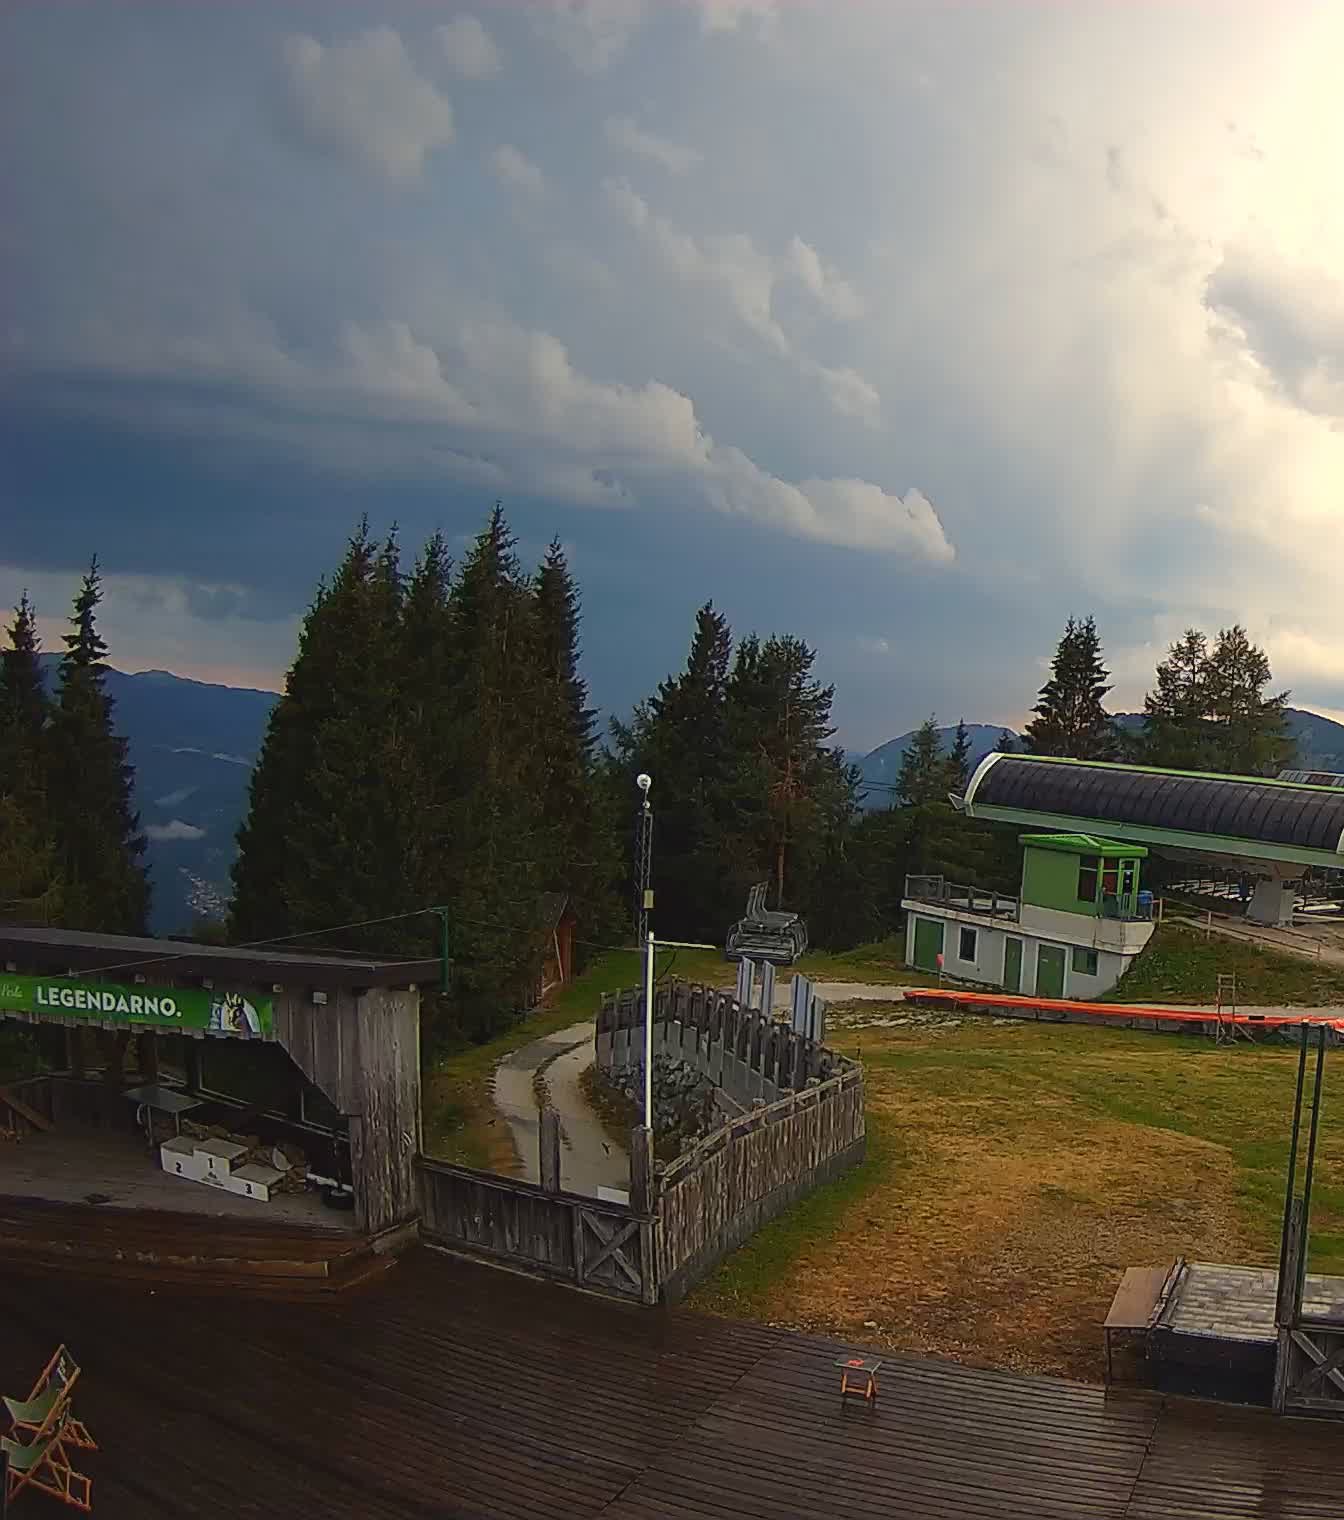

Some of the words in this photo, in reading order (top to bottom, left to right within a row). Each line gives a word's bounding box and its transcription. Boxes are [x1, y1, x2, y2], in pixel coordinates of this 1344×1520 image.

[37, 985, 182, 1018] LEGENDARNO.
[175, 1161, 183, 1174] 2
[207, 1157, 214, 1169] 1
[244, 1183, 253, 1195] 3
